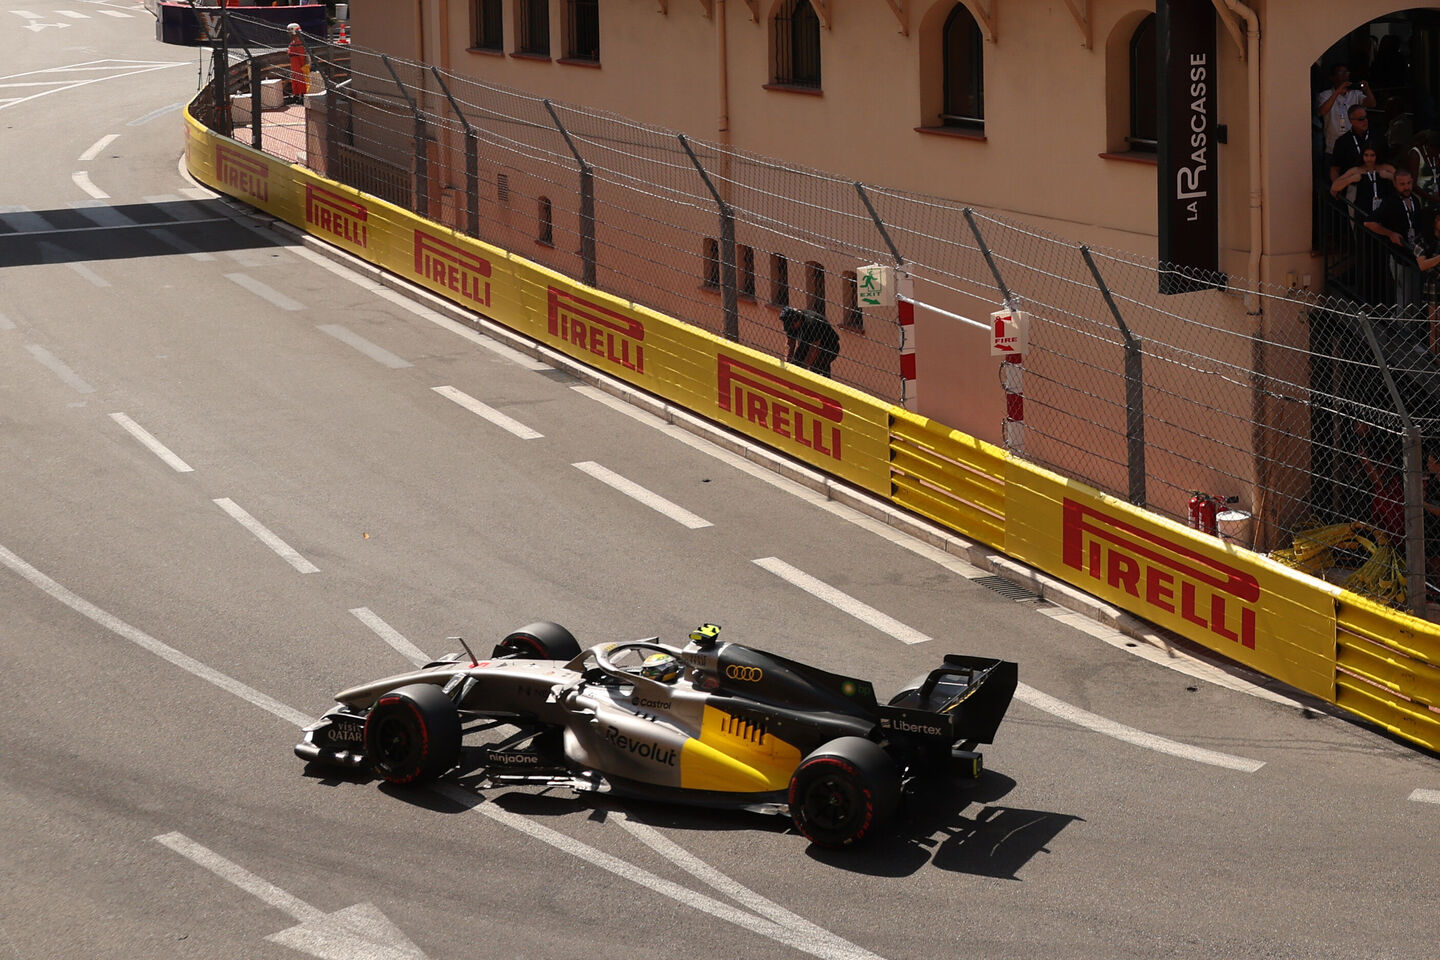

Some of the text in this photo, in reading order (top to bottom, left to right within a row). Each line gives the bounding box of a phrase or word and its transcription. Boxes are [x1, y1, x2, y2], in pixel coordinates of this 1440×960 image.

[1176, 53, 1207, 221] LA RASCASSE
[216, 144, 268, 203] PIRELLI
[305, 181, 368, 248] PIRELLI
[414, 228, 492, 308] PIRELLI
[548, 284, 645, 374] PIRELLI
[995, 336, 1017, 344] FIRE
[718, 353, 844, 461] PIRELLI
[1063, 497, 1260, 650] PIRELLI
[640, 698, 672, 710] Castrol
[893, 719, 942, 735] Libertex
[328, 729, 362, 742] QATAR
[489, 752, 538, 764] ninjaOne
[606, 725, 677, 766] Revolut
